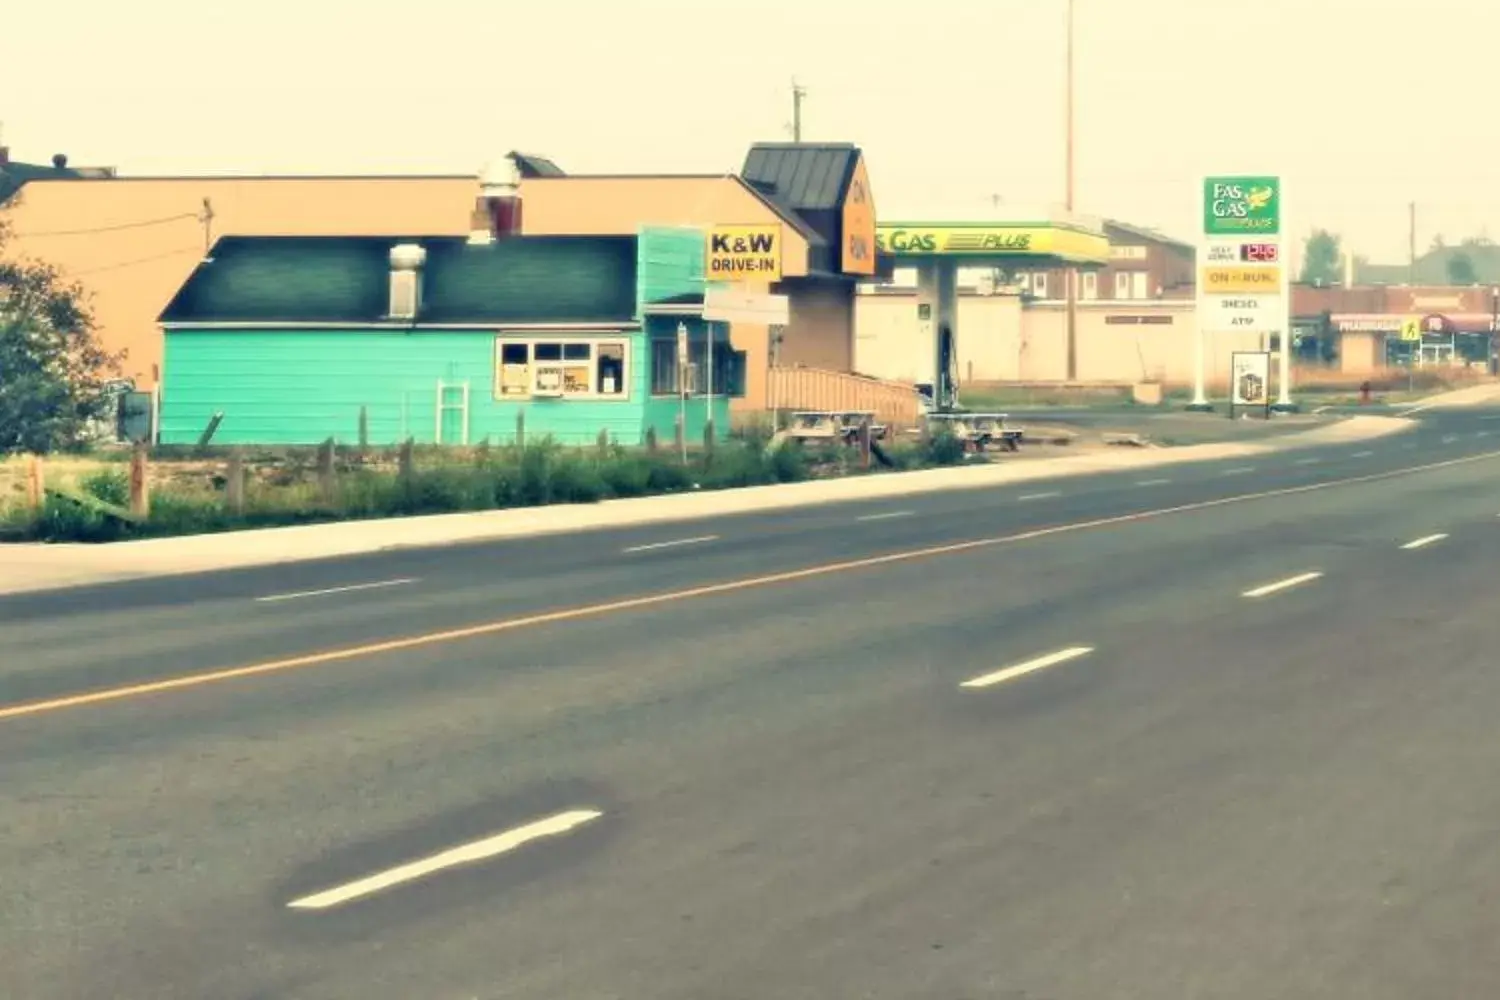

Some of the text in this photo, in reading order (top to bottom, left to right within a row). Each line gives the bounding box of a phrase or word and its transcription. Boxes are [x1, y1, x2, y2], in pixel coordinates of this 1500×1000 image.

[1212, 199, 1247, 217] GAS
[890, 230, 936, 251] GAS
[983, 233, 1031, 249] PLUS
[711, 258, 775, 272] DRIVE-IN
